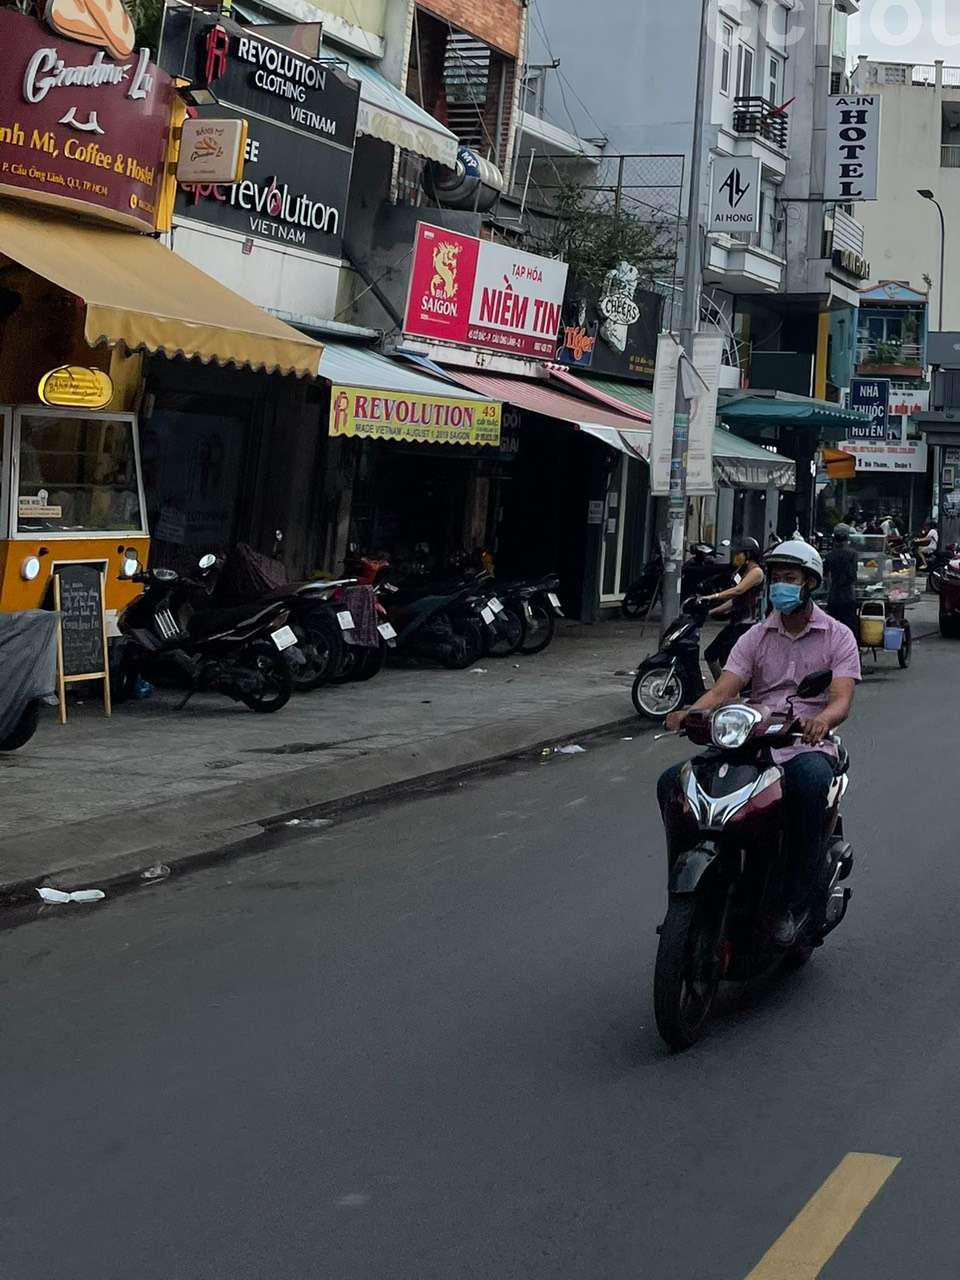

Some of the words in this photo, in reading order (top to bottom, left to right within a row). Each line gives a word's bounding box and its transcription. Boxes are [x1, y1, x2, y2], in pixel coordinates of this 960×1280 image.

[238, 38, 326, 90] REVOLUTION
[255, 70, 306, 103] CLOTHING
[836, 97, 874, 106] A-IN
[290, 104, 336, 135] VIETNAM
[64, 138, 112, 169] Coffee
[114, 154, 124, 173] &
[838, 110, 868, 197] HOTEL
[249, 217, 306, 244] VIETNAM
[726, 214, 753, 222] HONG
[512, 263, 526, 281] TẠP
[421, 296, 458, 317] SAIGON
[479, 274, 529, 329] NIỀM
[532, 298, 561, 336] TIN
[605, 299, 637, 320] CHEERS
[564, 325, 594, 361] Tiger
[860, 383, 879, 398] NHÀ
[353, 395, 475, 428] REVOLUTION
[482, 406, 496, 418] 43
